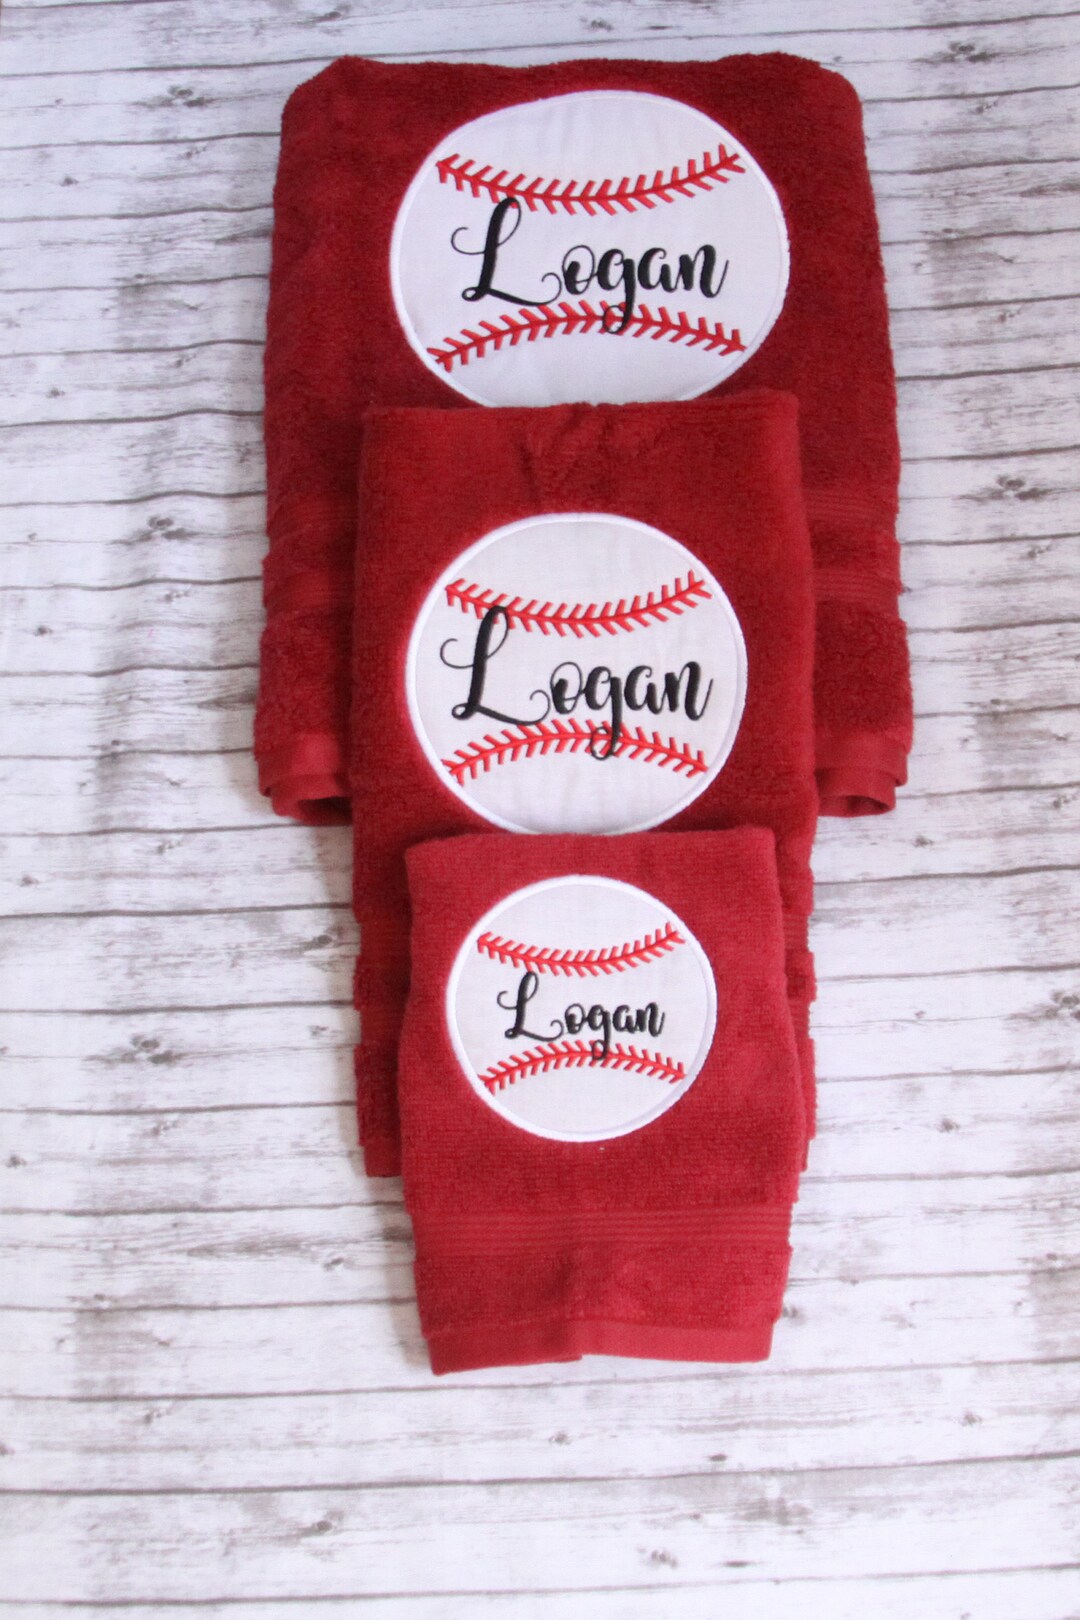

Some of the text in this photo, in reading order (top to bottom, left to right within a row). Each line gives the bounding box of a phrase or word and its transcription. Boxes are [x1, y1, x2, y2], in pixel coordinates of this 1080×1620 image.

[451, 197, 729, 334] Logan
[440, 605, 713, 760] Logan
[497, 971, 665, 1061] Logan
